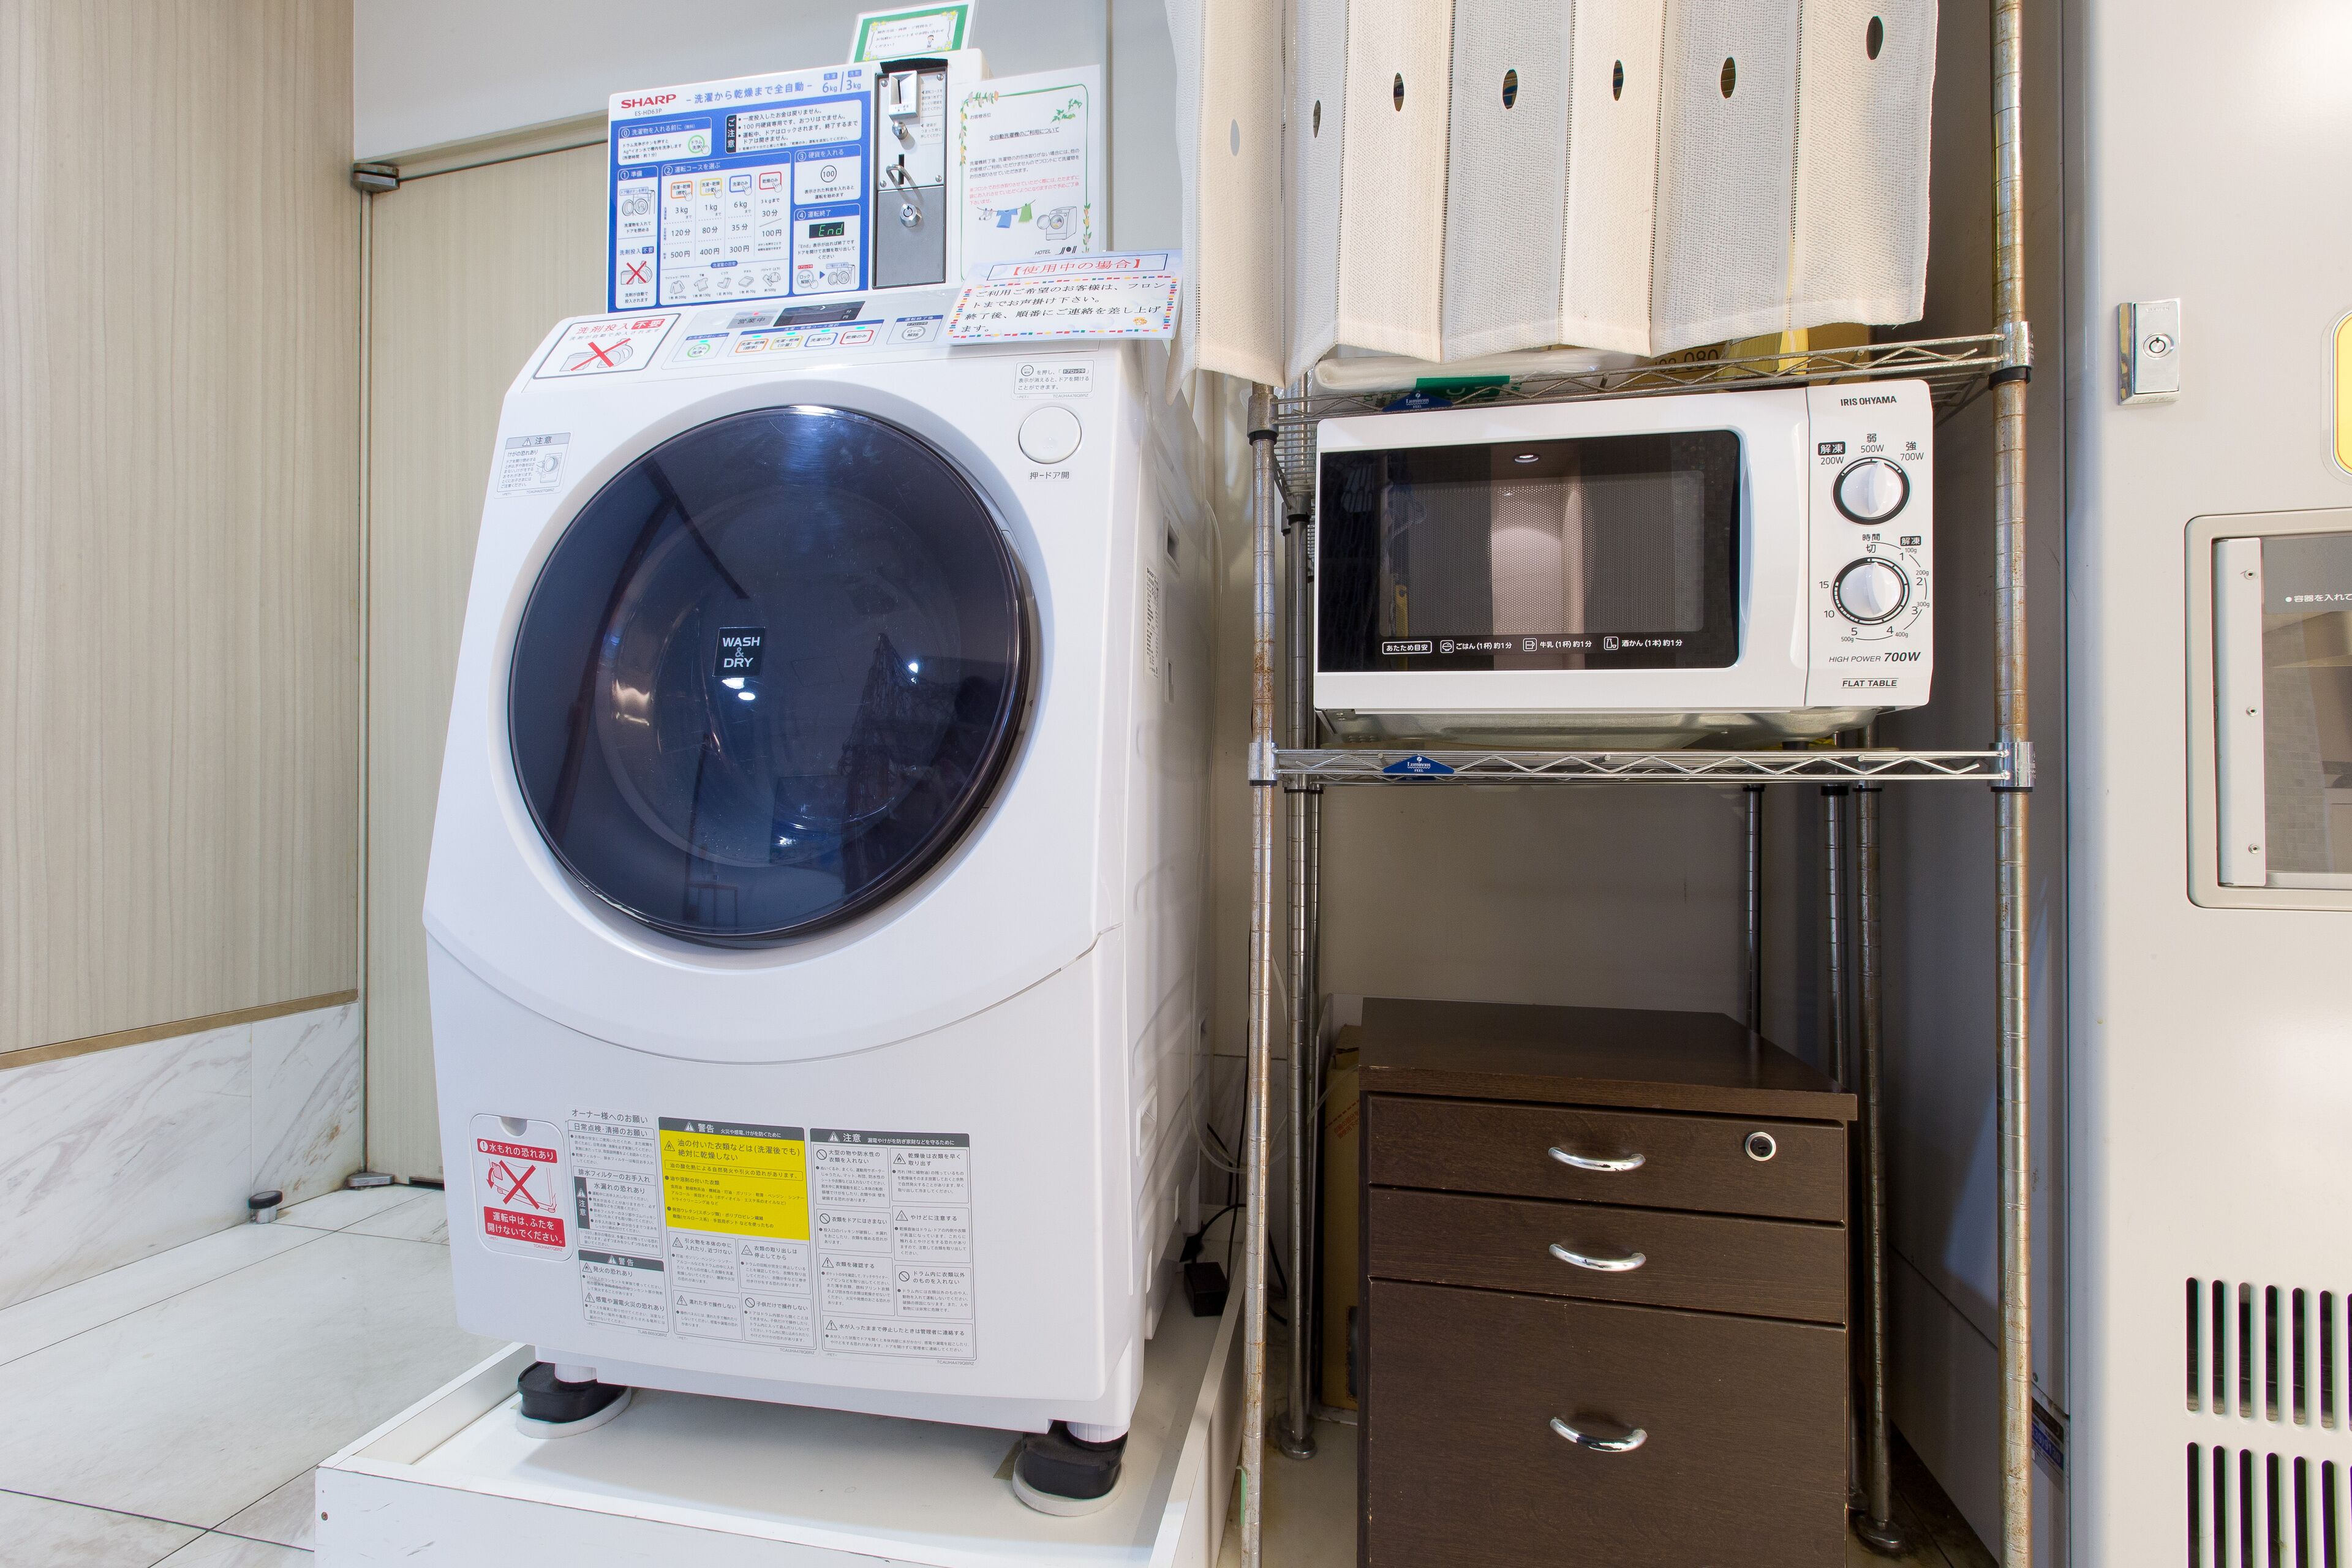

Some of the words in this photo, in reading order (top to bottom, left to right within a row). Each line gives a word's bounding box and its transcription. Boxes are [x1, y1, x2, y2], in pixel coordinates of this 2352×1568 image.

[695, 81, 804, 104] 洗濯から乾燥まで全自動
[621, 94, 677, 108] SHARP
[743, 108, 822, 121] 一度投入したお金は戻りません。
[631, 124, 682, 135] 洗濯物を入れる前に
[989, 127, 1060, 140] 全自動洗濯機のご利用について
[808, 149, 844, 159] 硬貨を入れる
[674, 162, 721, 173] 運転コースを選ぶ
[671, 228, 691, 237] 120分
[761, 229, 782, 238] 100円
[818, 223, 844, 238] End
[729, 245, 750, 254] 300円
[1012, 258, 1142, 276] 【使用中の場合】
[973, 296, 1101, 309] トまでお声掛け下さい。
[965, 306, 1162, 321] 終了後、順番にご連絡を差し上げ
[576, 322, 633, 334] 洗剤投入
[633, 320, 664, 329] 不要
[960, 325, 992, 333] ます。
[1840, 398, 1858, 407] IRIS
[1859, 396, 1897, 405] OHYAMA
[534, 435, 552, 445] 注意
[1866, 433, 1877, 443] 弱
[1820, 443, 1844, 454] 解凍
[1860, 444, 1885, 453] 500W
[1905, 441, 1917, 451] 強
[1820, 456, 1844, 466] 200W
[1900, 452, 1924, 461] 700W
[1862, 533, 1880, 541] 時間
[1901, 536, 1921, 546] 解凍
[1866, 544, 1876, 554] 切
[1899, 552, 1904, 561] 1
[1916, 577, 1923, 586] 2
[1911, 606, 1918, 615] 3
[1850, 627, 1858, 636] 5
[1886, 625, 1894, 635] 4
[722, 636, 760, 647] WASH
[1476, 642, 1493, 651] (1杯)
[1539, 641, 1555, 649] 牛乳
[1555, 641, 1571, 649] (1杯)
[1572, 640, 1593, 649] 約1分
[1621, 639, 1643, 647] 酒かん
[1644, 639, 1662, 647] (1本)
[1662, 638, 1683, 647] 約1分
[735, 647, 744, 658] &
[1385, 643, 1429, 652] あたため目安
[1883, 651, 1921, 662] 700W
[723, 657, 754, 668] DRY
[571, 1109, 648, 1124] オーナー様へのお願い
[698, 1123, 715, 1134] 警告
[842, 1133, 862, 1143] 注意
[489, 1143, 554, 1161] 水もれの恐れあり
[677, 1149, 739, 1161] 絶対に乾燥しない
[828, 1149, 881, 1158] 大型の物や防水性の
[829, 1156, 870, 1164] 衣類を入れない
[578, 1168, 651, 1183] 排水フィルターのお手入れ
[670, 1175, 720, 1186] 油や溶剤の付いた衣類
[594, 1182, 646, 1194] 水漏れの恐れあり
[578, 1199, 587, 1216] 注意
[492, 1211, 555, 1231] 運転中は、ふたを
[831, 1216, 888, 1225] 衣類をドアにはさまない
[487, 1222, 563, 1244] 開けないでください。
[684, 1238, 732, 1248] 引火物を本体の中に
[685, 1245, 733, 1255] 入れたり、近づけない
[754, 1245, 797, 1254] 衣類の取り出しは
[618, 1257, 634, 1267] 警告
[593, 1266, 633, 1277] 発火の恐れあり
[595, 1296, 665, 1311] 感電や漏電火災の恐れあり
[689, 1299, 737, 1309] 濡れた手で操作しない
[756, 1301, 808, 1311] 子供だけで操作しない
[839, 1323, 965, 1336] 水が入ったままで停止したときは管理者に連絡する
